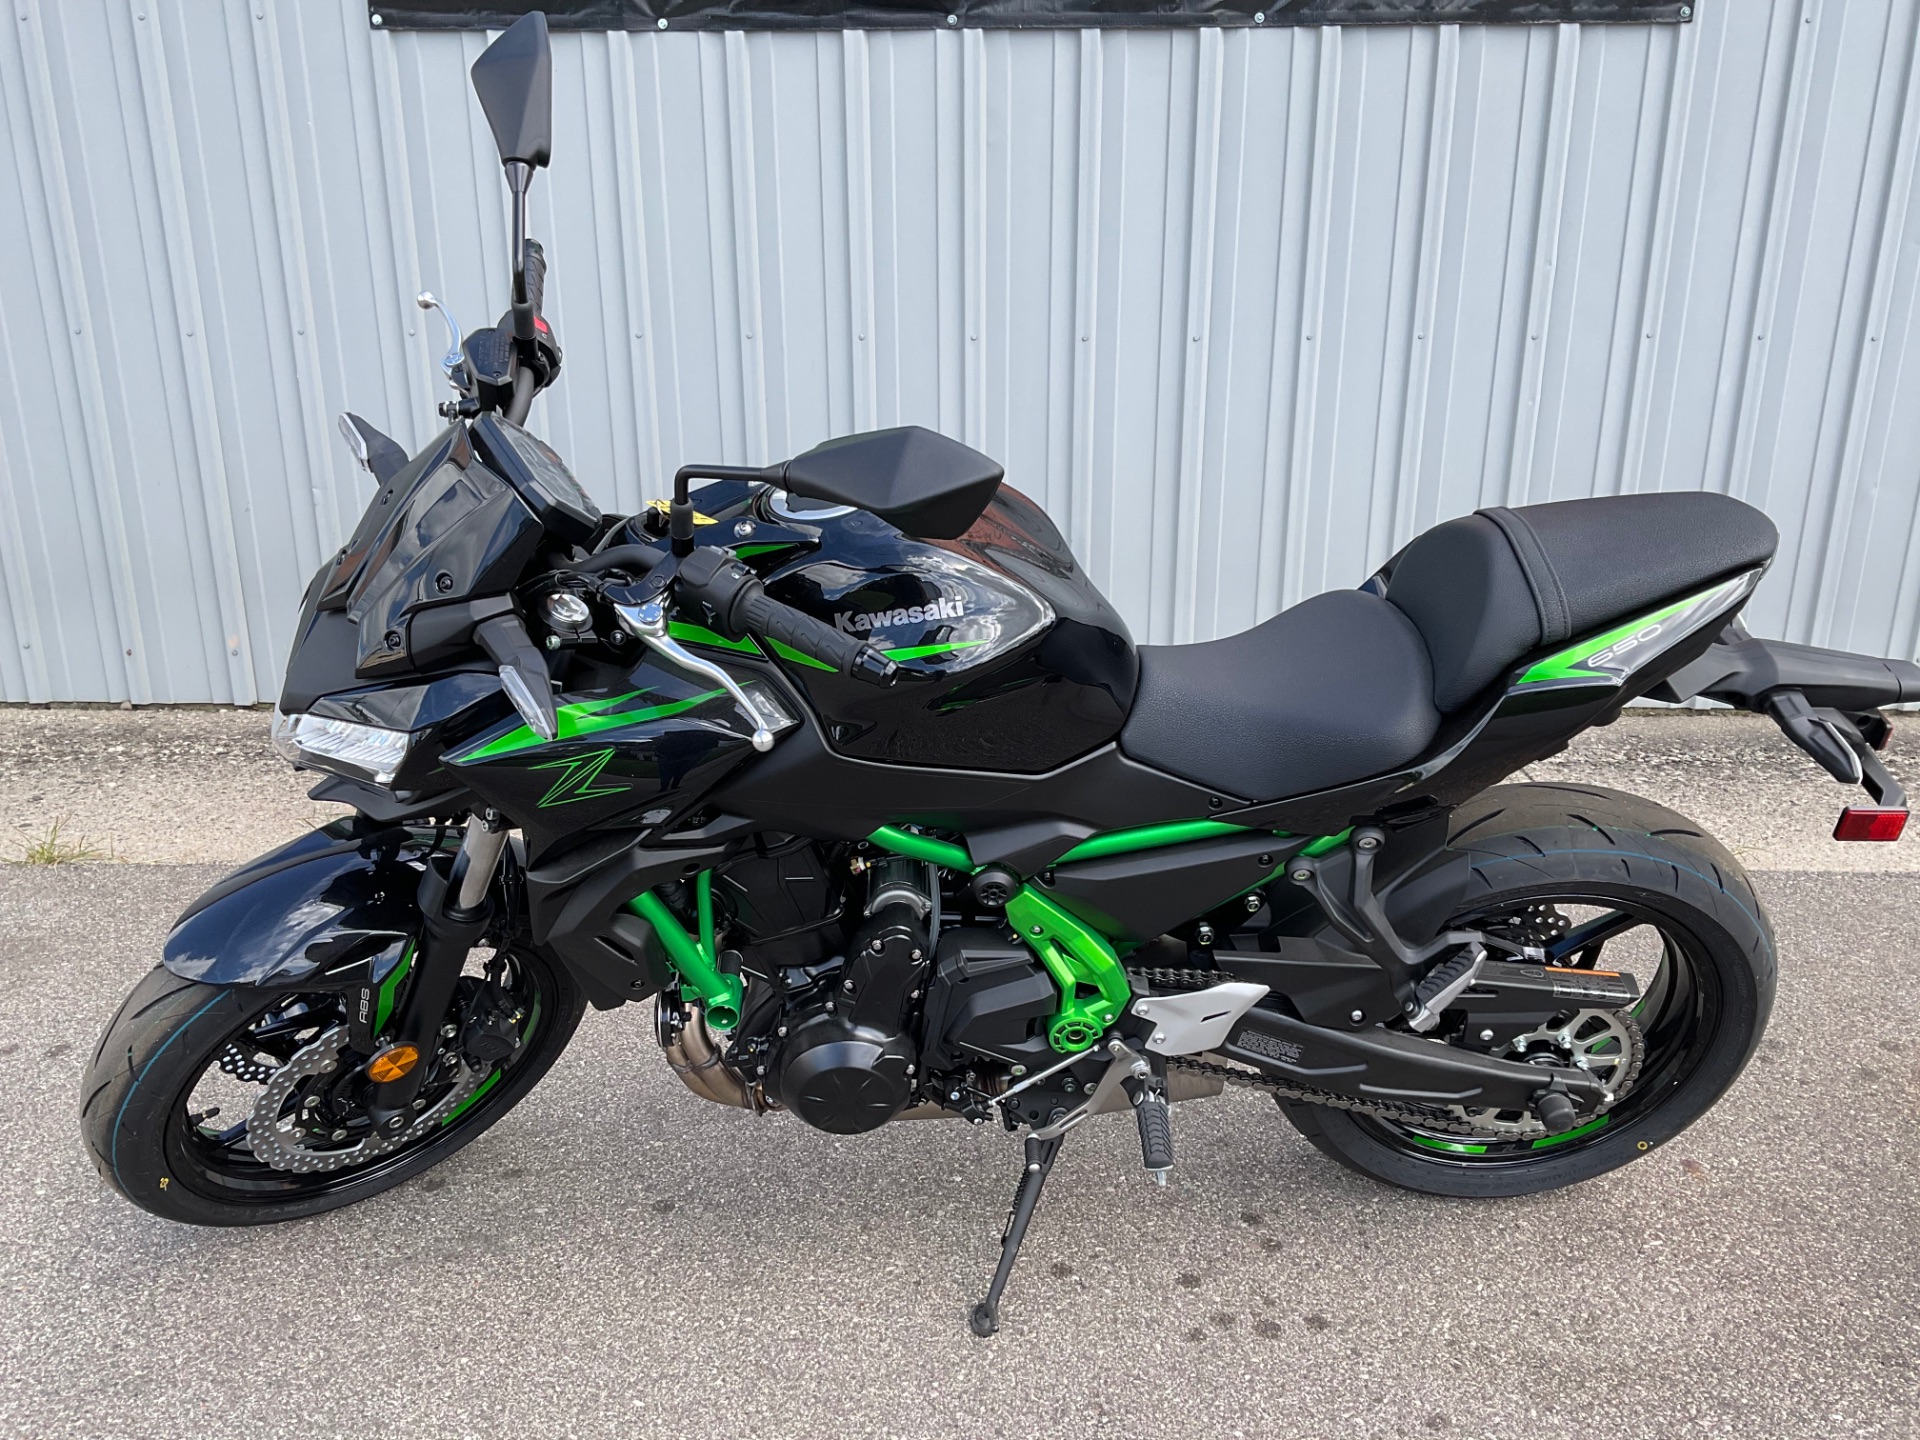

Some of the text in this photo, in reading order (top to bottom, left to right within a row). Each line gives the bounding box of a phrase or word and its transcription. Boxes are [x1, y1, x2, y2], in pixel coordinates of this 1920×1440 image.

[833, 596, 964, 633] Kawasaki
[1587, 624, 1662, 667] 650
[527, 747, 633, 809] Z
[358, 987, 370, 1024] ABS
